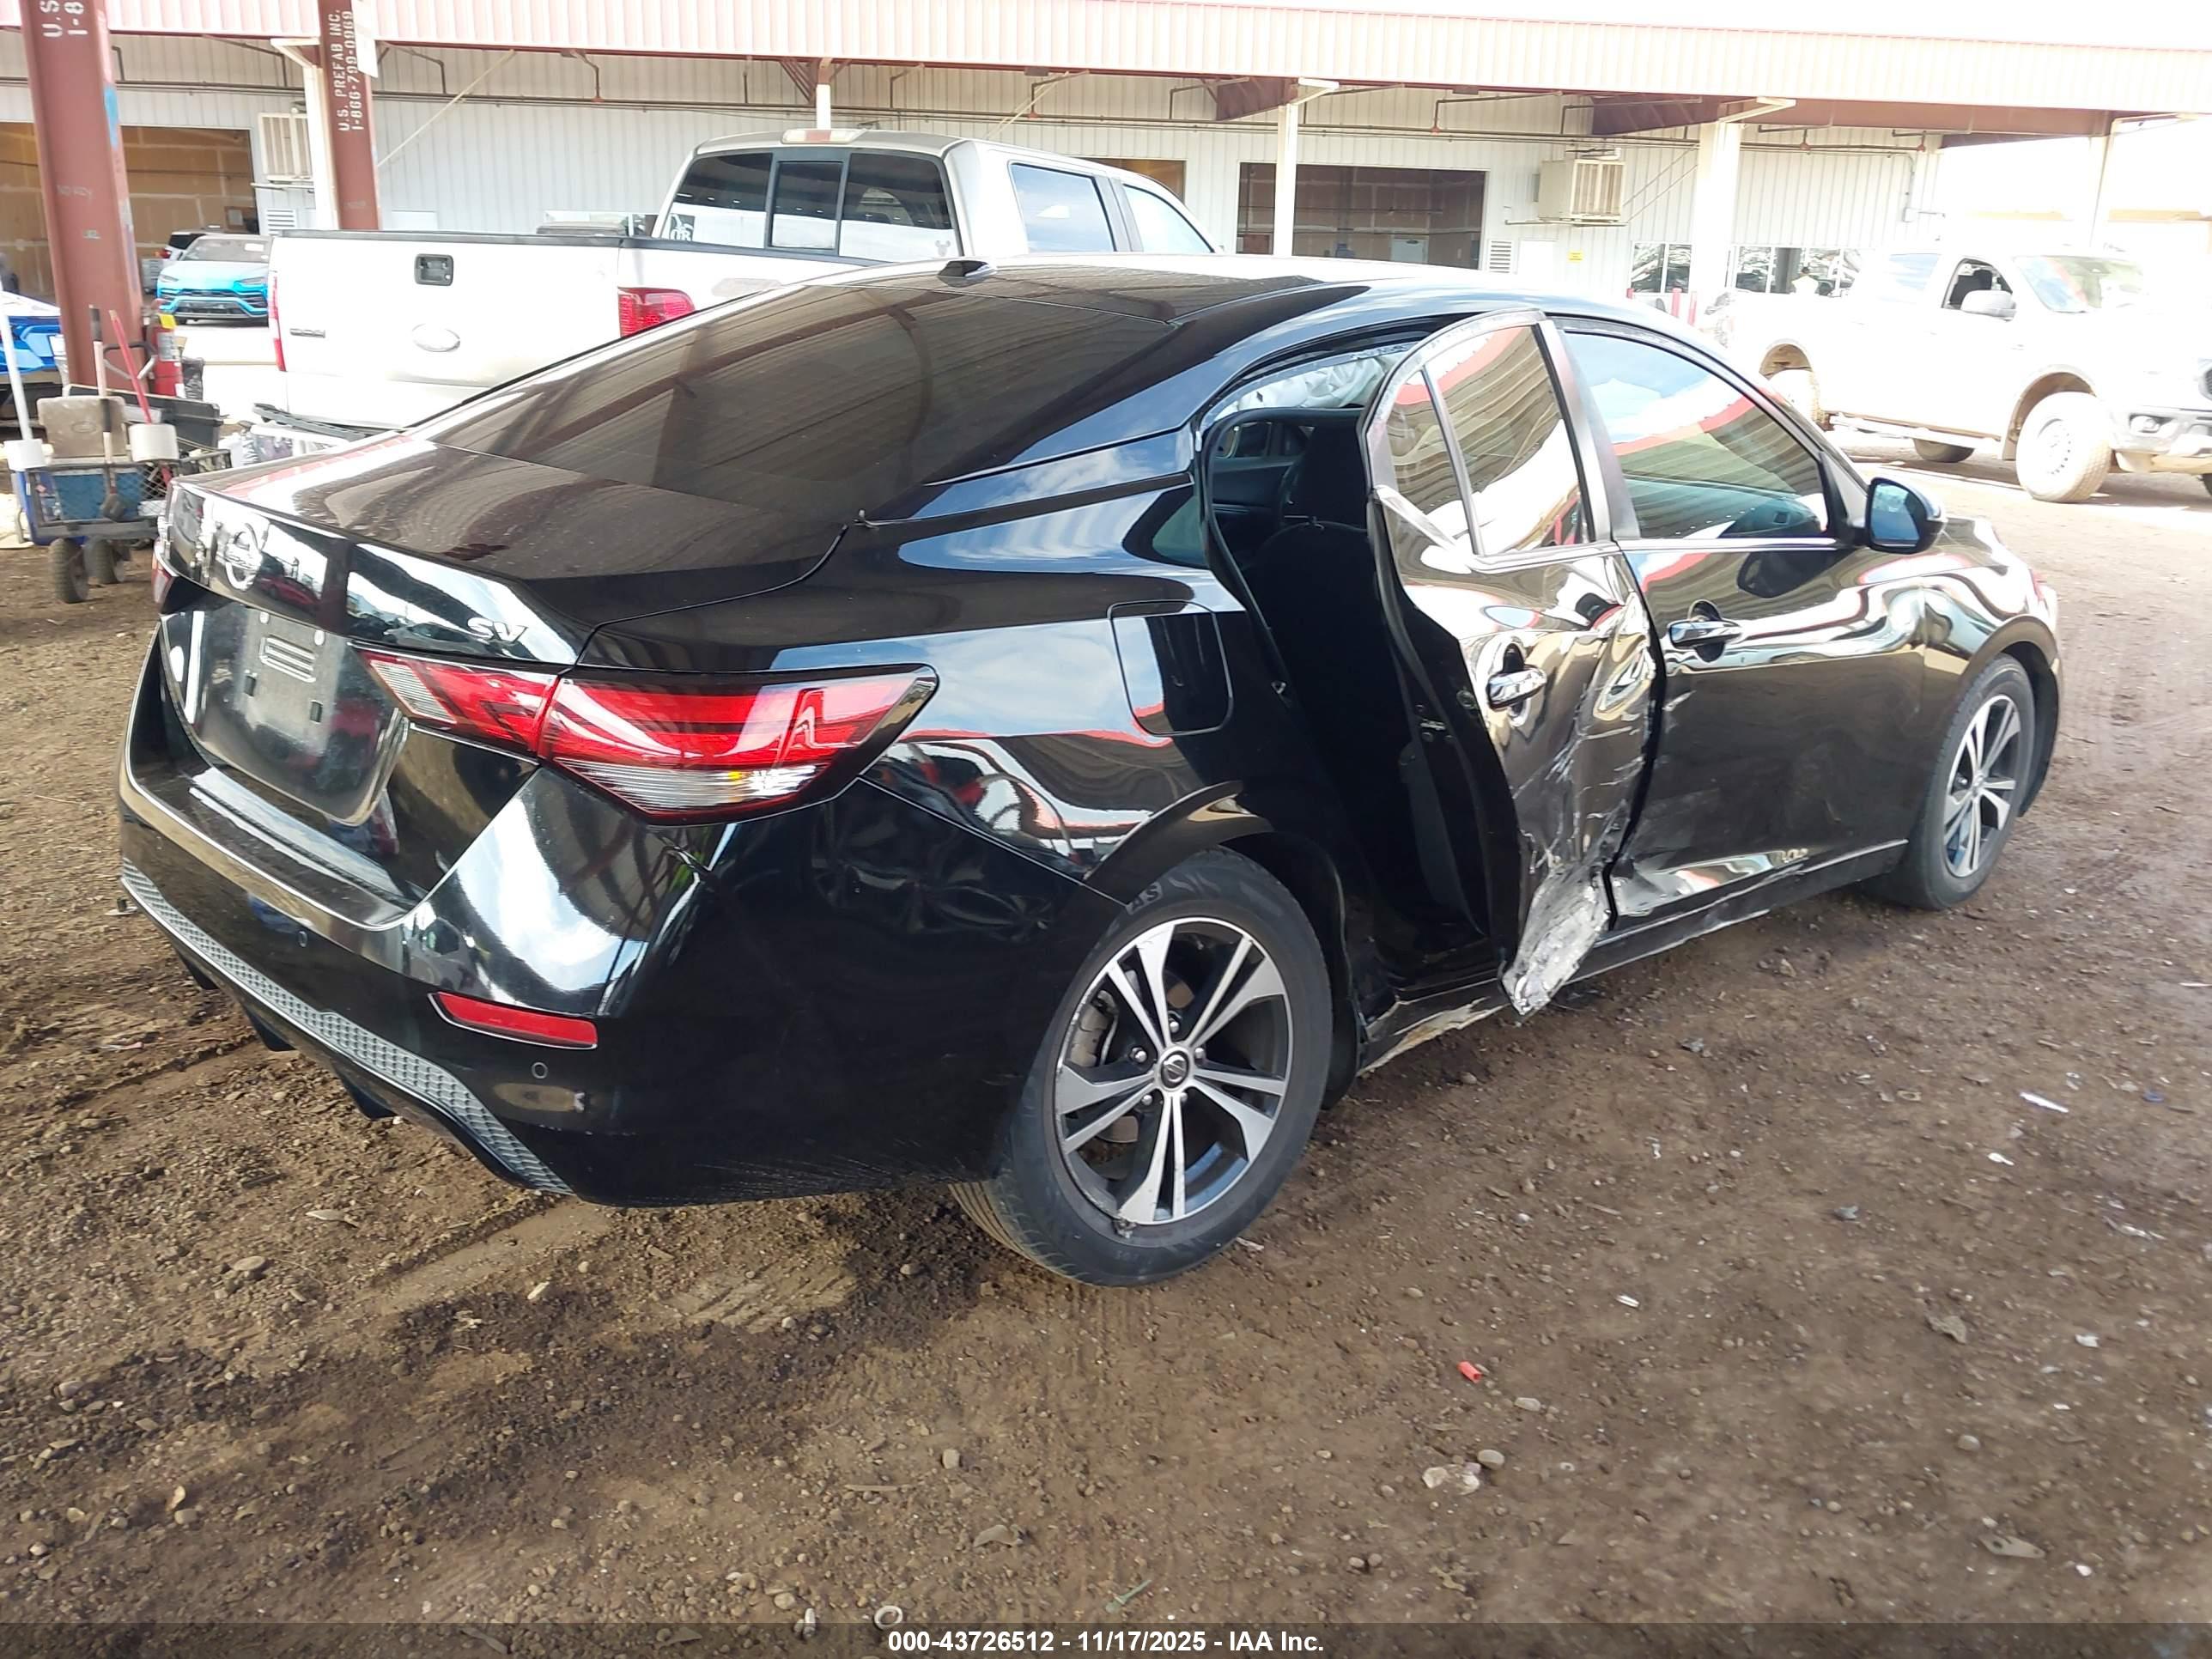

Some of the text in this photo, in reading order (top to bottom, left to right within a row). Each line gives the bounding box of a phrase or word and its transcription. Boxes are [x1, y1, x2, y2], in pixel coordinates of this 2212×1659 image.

[328, 9, 349, 131] U.S. PREFAB INC.
[467, 617, 529, 643] SV
